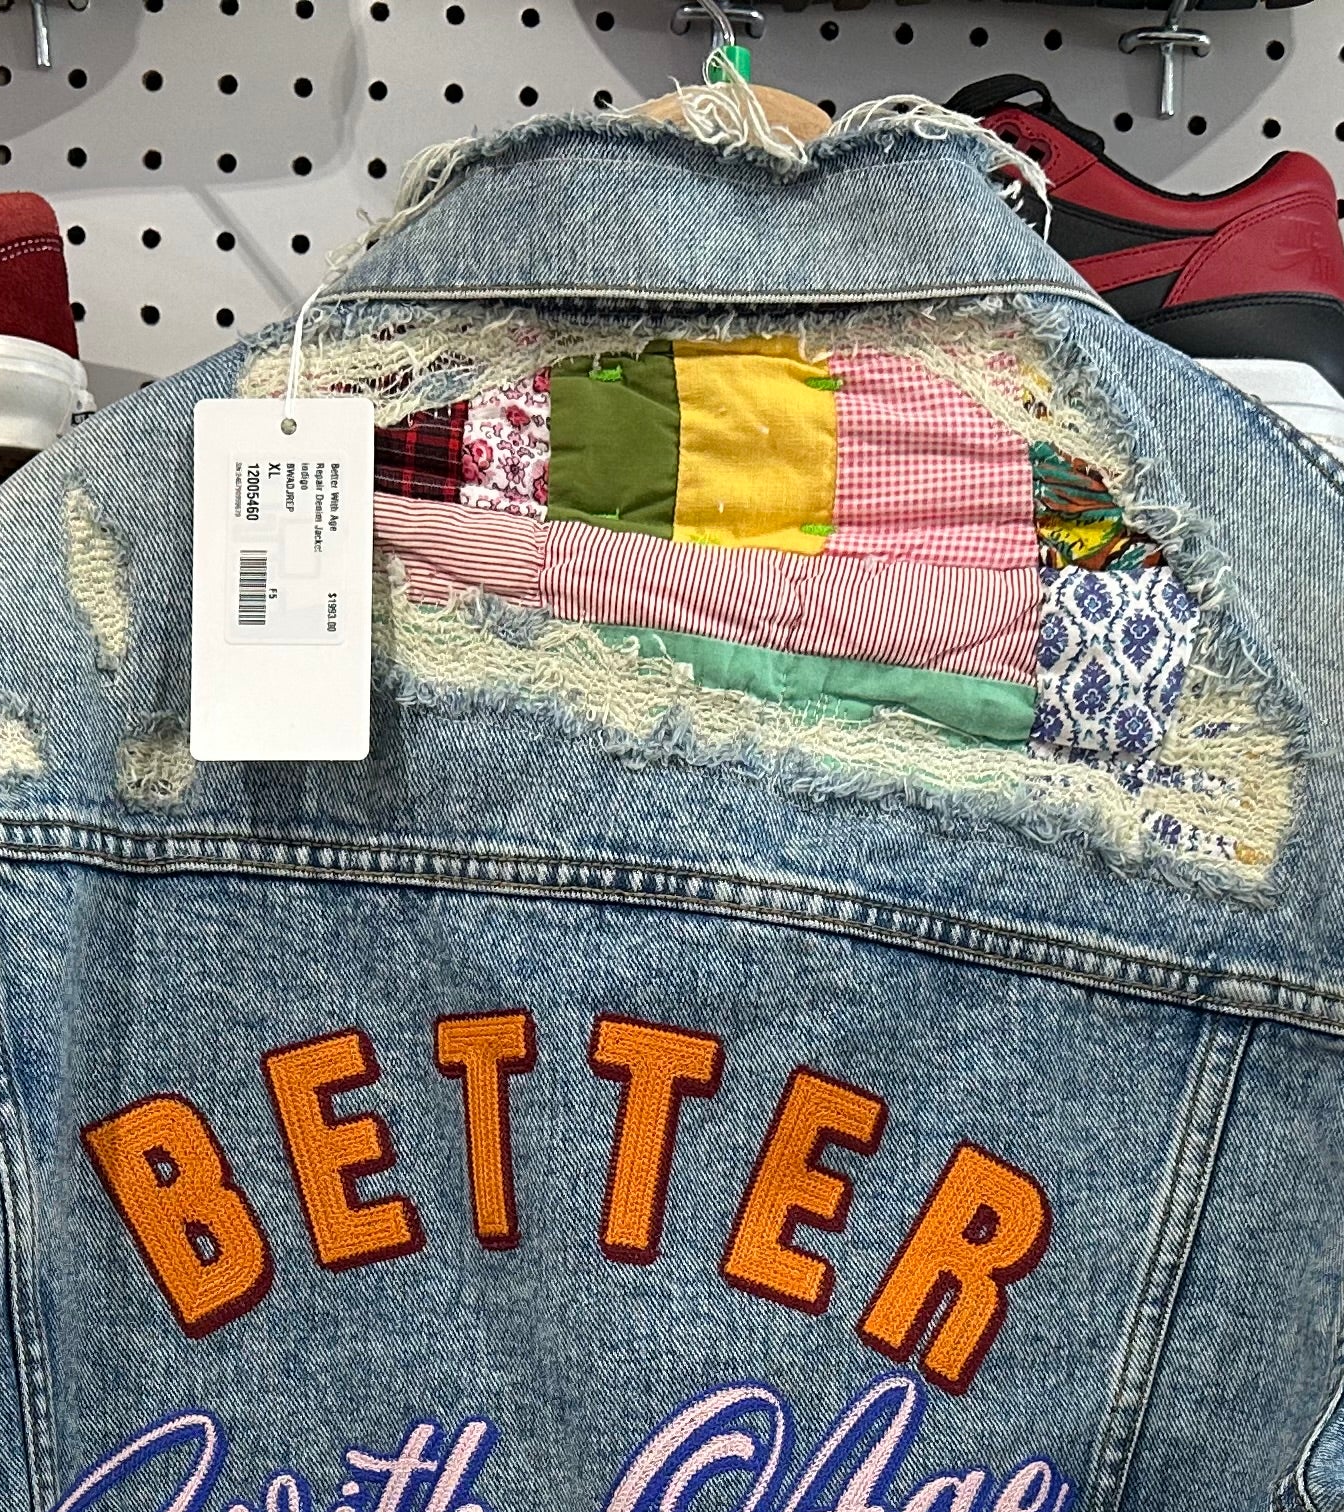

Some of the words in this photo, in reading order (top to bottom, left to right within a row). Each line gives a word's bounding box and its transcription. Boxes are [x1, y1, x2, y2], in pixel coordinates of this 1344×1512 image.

[268, 462, 281, 480] XL
[314, 462, 325, 492] Repair
[330, 462, 340, 489] Better
[245, 462, 260, 521] 12005460
[329, 492, 340, 513] With
[314, 494, 324, 523] Denim
[327, 514, 339, 532] Age
[268, 588, 278, 600] F5
[80, 1010, 1053, 1394] BETTER
